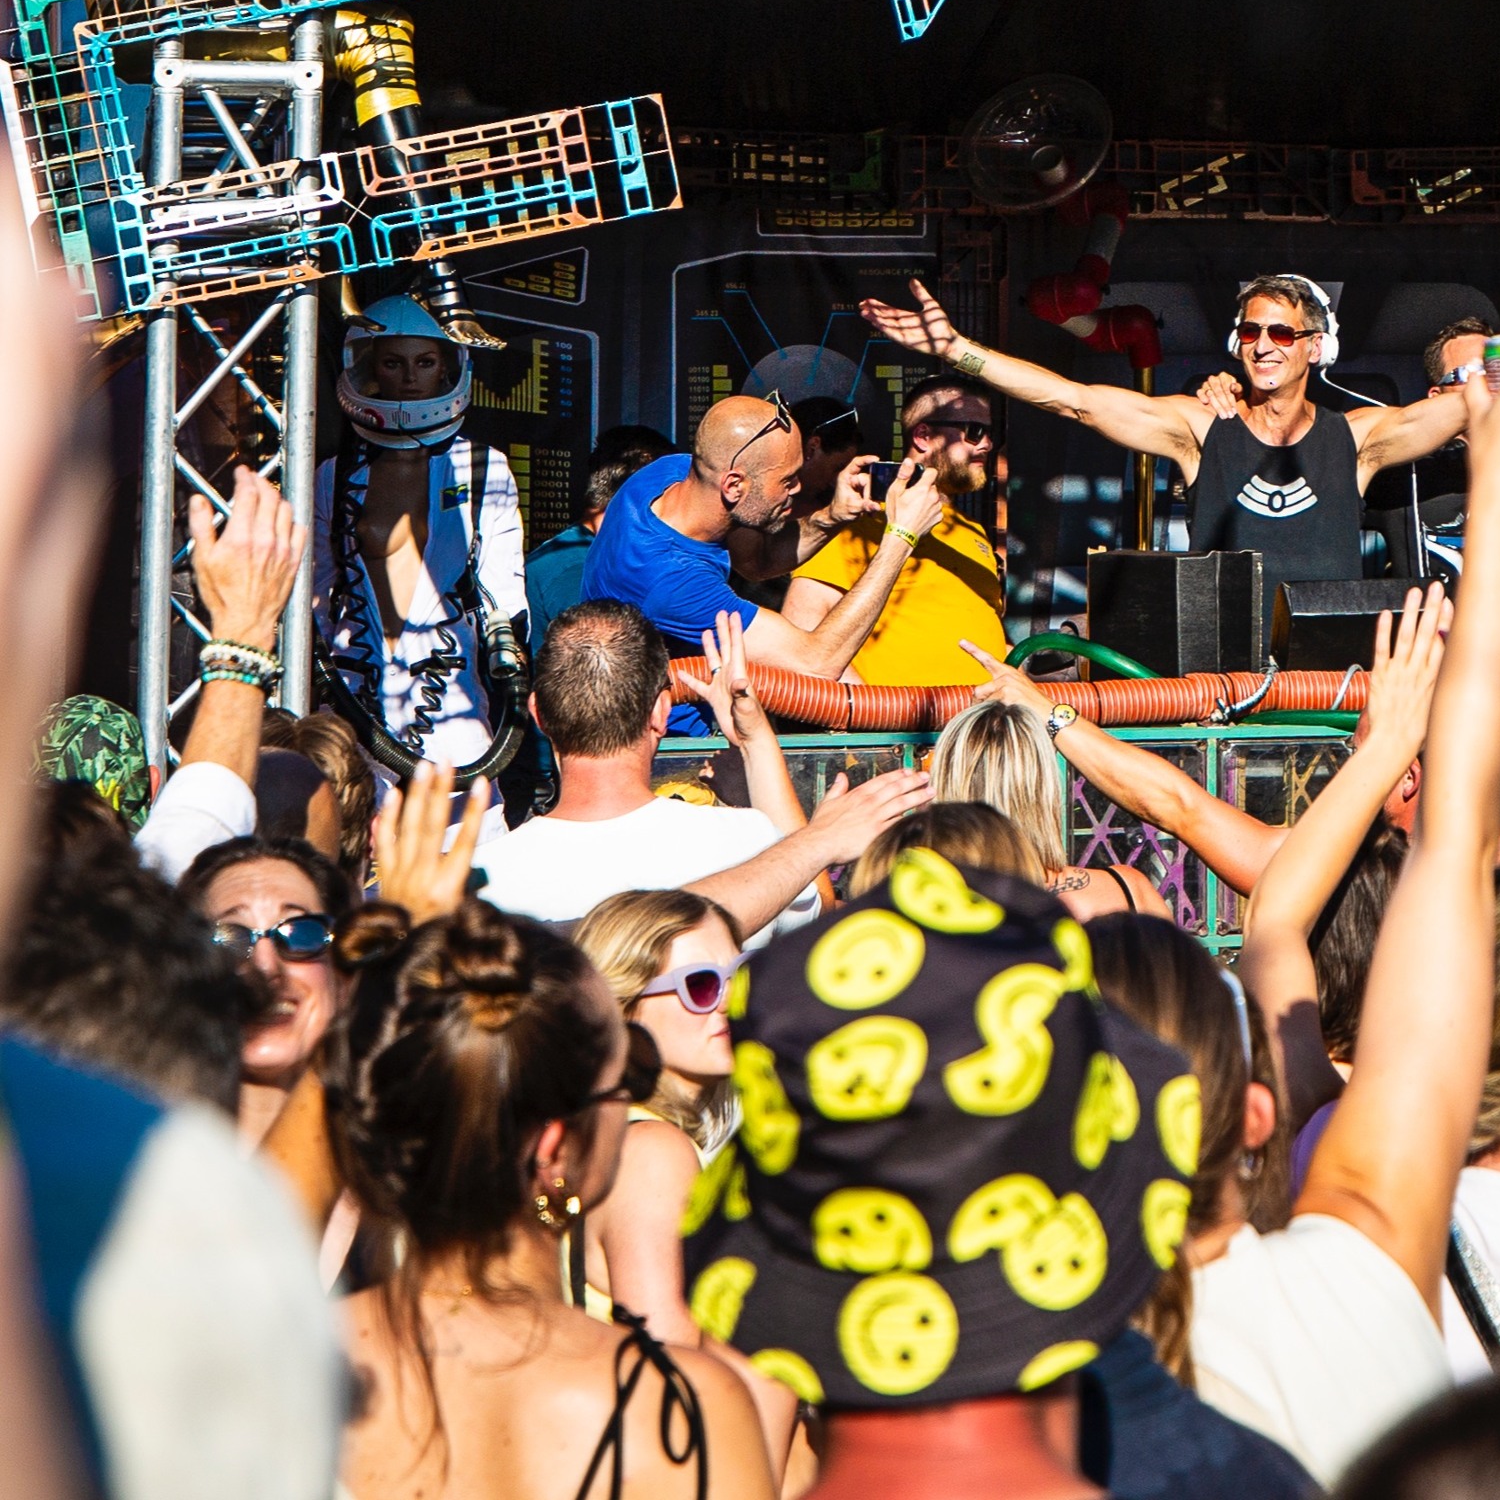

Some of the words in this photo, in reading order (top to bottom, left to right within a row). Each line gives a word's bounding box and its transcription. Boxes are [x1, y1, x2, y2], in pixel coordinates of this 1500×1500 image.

[858, 268, 902, 276] RESOURCE
[554, 341, 573, 350] 100
[560, 377, 573, 385] 70
[534, 448, 571, 458] 00100
[535, 469, 570, 478] 10101
[534, 490, 570, 499] 00011
[534, 501, 570, 509] 01101
[534, 511, 571, 520] 00110
